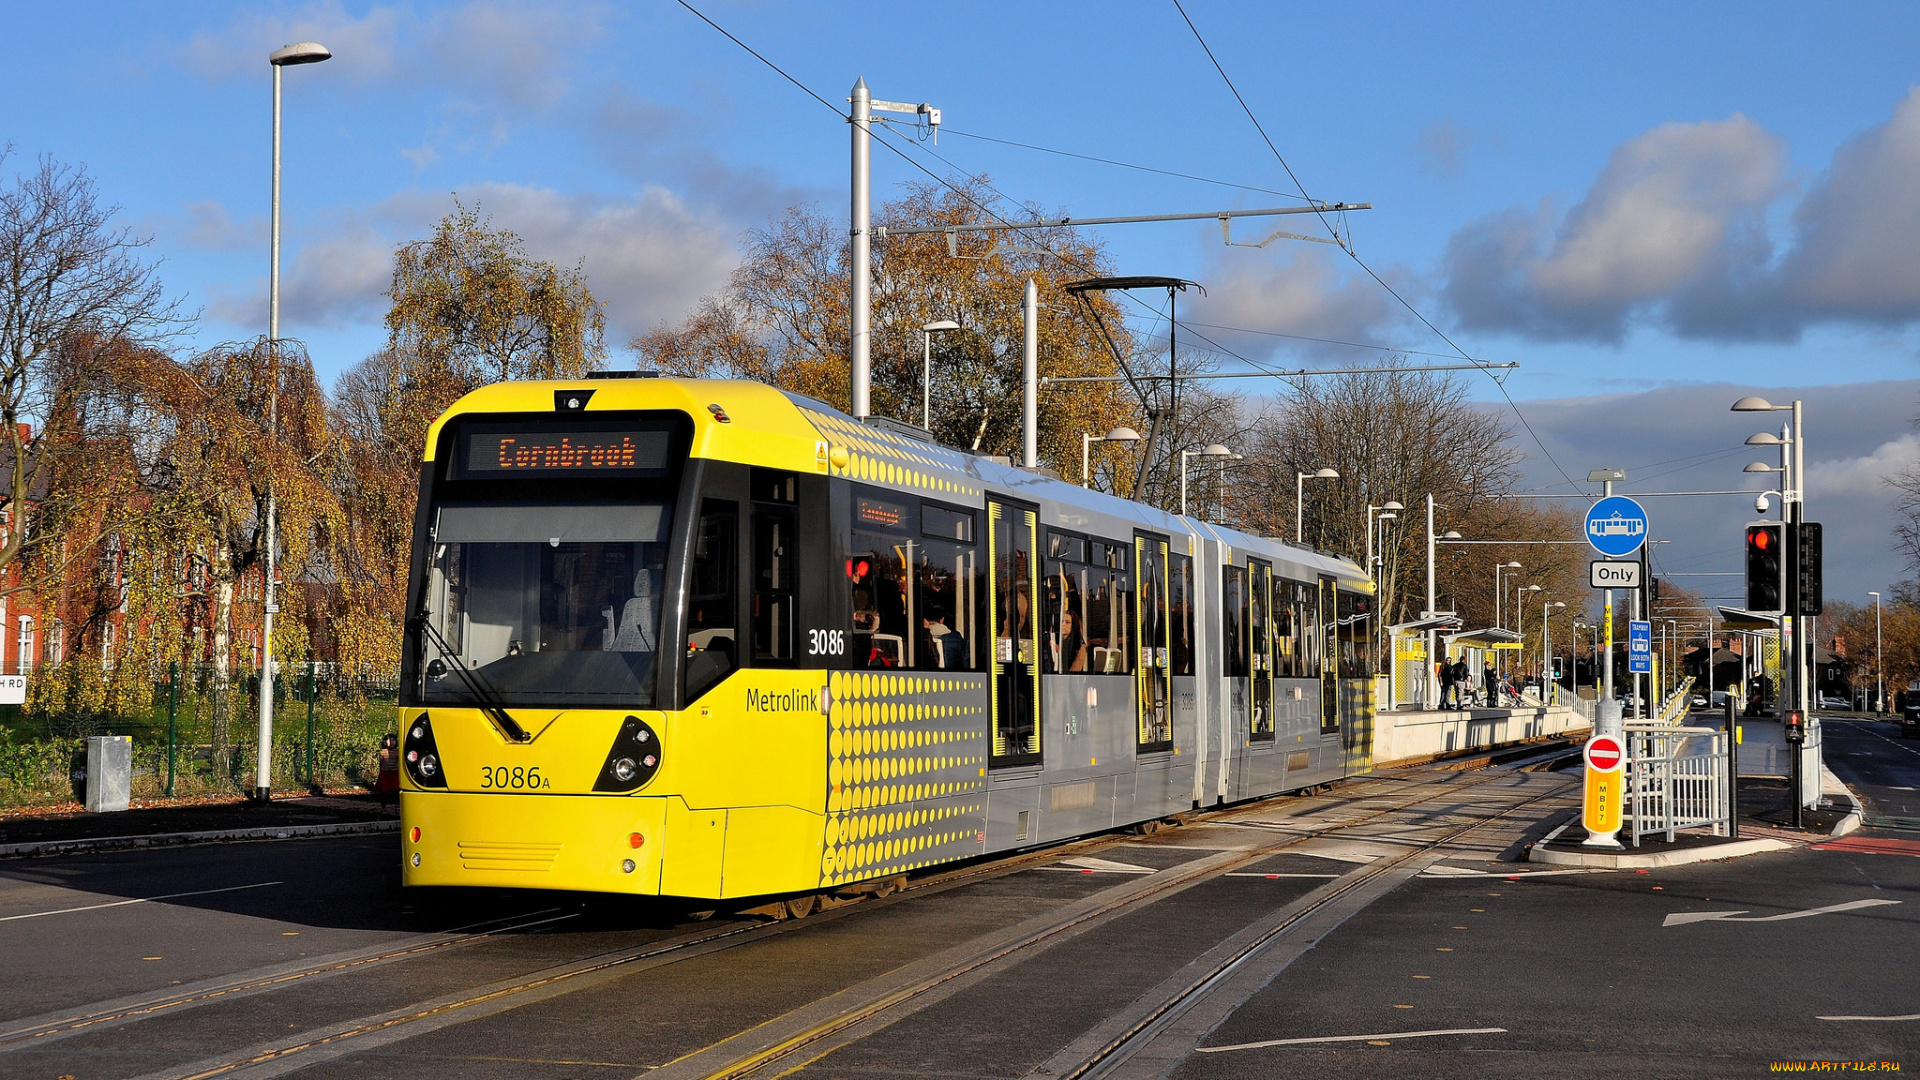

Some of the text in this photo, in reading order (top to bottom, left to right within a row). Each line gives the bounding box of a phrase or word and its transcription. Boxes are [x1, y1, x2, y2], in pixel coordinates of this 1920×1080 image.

[498, 437, 637, 469] Cornbrook
[1598, 567, 1634, 582] Only
[808, 628, 845, 656] 3086
[9, 679, 23, 688] RD
[746, 688, 818, 712] Metrolink
[1599, 785, 1607, 821] MB07
